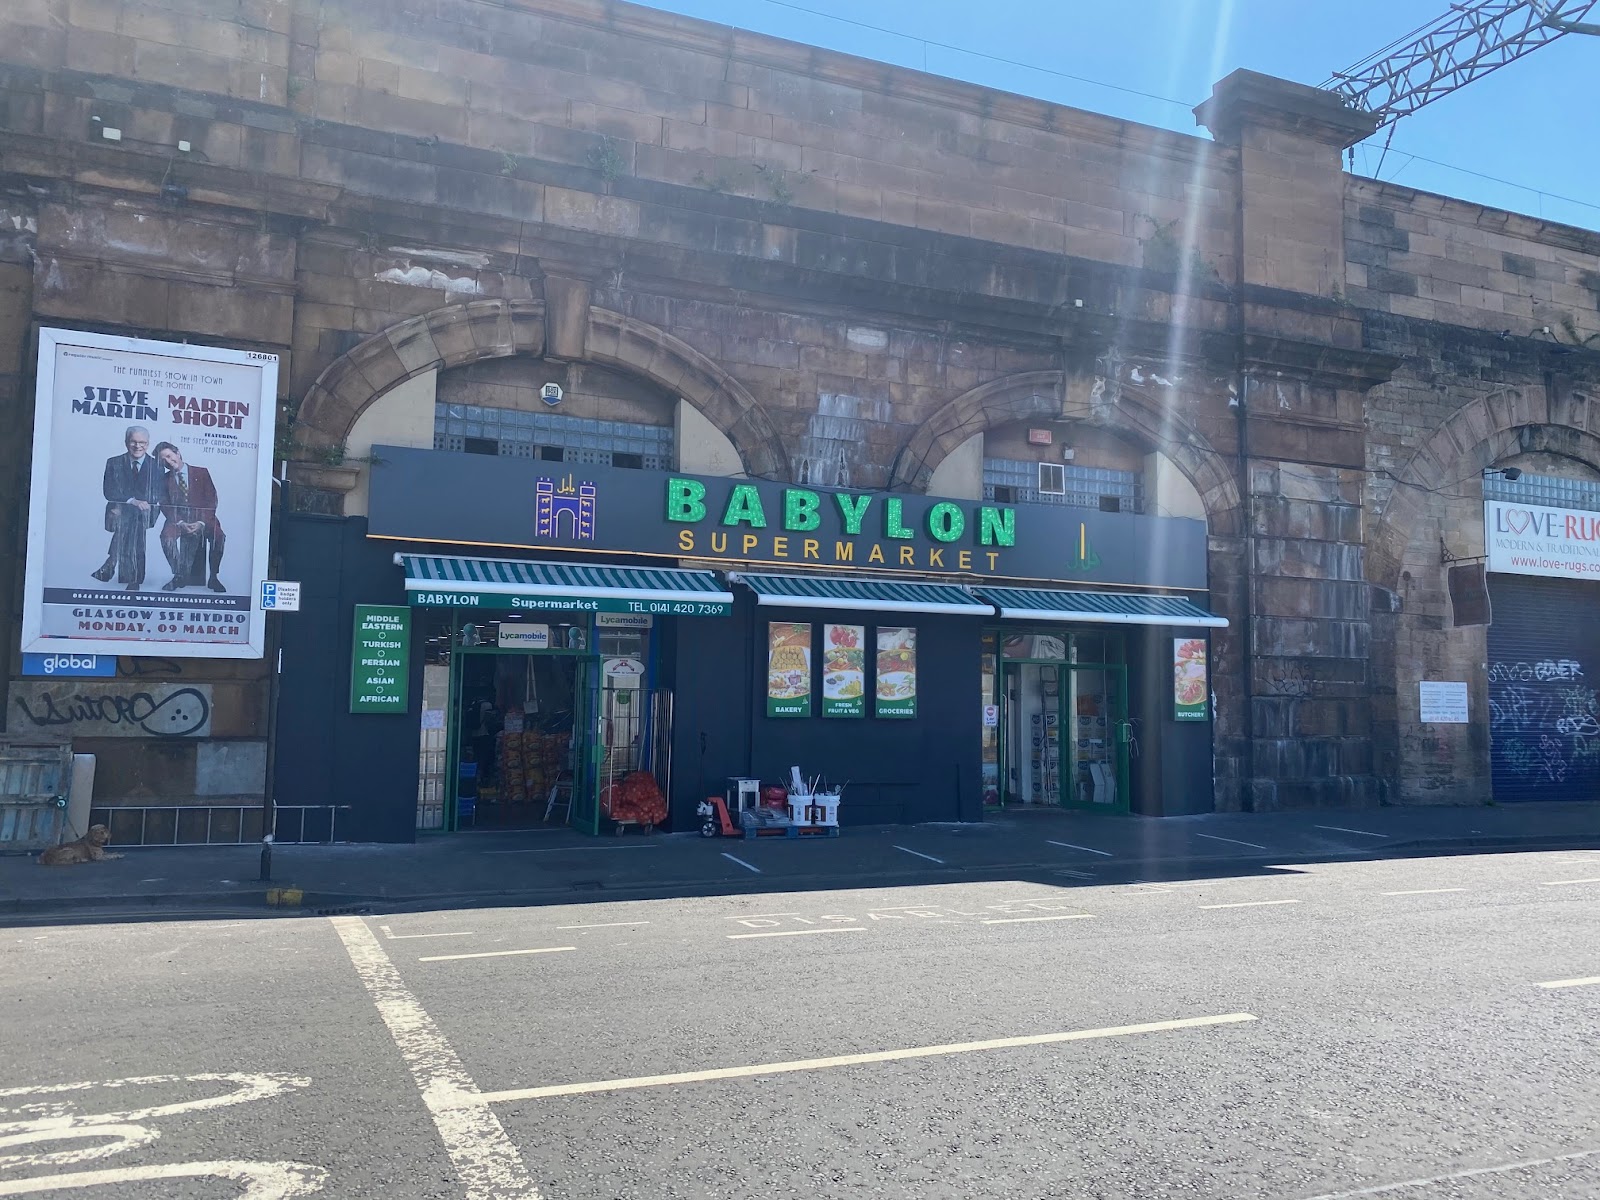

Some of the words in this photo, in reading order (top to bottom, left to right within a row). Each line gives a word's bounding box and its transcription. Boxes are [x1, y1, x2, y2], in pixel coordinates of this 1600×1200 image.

[248, 352, 277, 361] 126801
[113, 365, 126, 374] THE
[129, 368, 161, 378] FUNNIEST
[165, 371, 187, 381] SHOW
[190, 374, 198, 382] IN
[201, 375, 223, 385] TOWN
[153, 380, 163, 388] THE
[166, 381, 194, 391] MOMENT
[84, 386, 149, 405] STEVE
[71, 399, 158, 421] MARTIN
[168, 394, 249, 416] MARTIN
[172, 410, 244, 430] SHORT
[556, 473, 576, 495] بابل
[668, 477, 1015, 546] BABYLON
[678, 529, 1000, 571] SUPERMARKET
[1496, 538, 1535, 550] MODERN
[1537, 542, 1544, 552] &
[266, 584, 275, 594] P
[418, 594, 479, 606] BABYLON
[511, 597, 599, 610] Supermarket
[628, 601, 648, 612] TEL.
[650, 603, 670, 613] 0141
[673, 604, 695, 613] 420
[698, 604, 724, 615] 7369
[73, 608, 153, 620] GLASGOW
[160, 611, 184, 621] SSE
[190, 612, 246, 623] HYDRO
[366, 614, 400, 623] MIDDLE
[600, 615, 648, 625] Lycamobile
[79, 621, 151, 633] MONDAY,
[158, 623, 177, 633] 09
[183, 624, 239, 635] MARCH
[362, 622, 403, 631] EASTERN
[363, 640, 401, 648] TURKISH
[500, 631, 547, 643] Lycamobile
[43, 654, 96, 674] global
[362, 658, 400, 667] PERSIAN
[366, 677, 395, 685] ASIAN
[360, 695, 400, 703] AFRICAN
